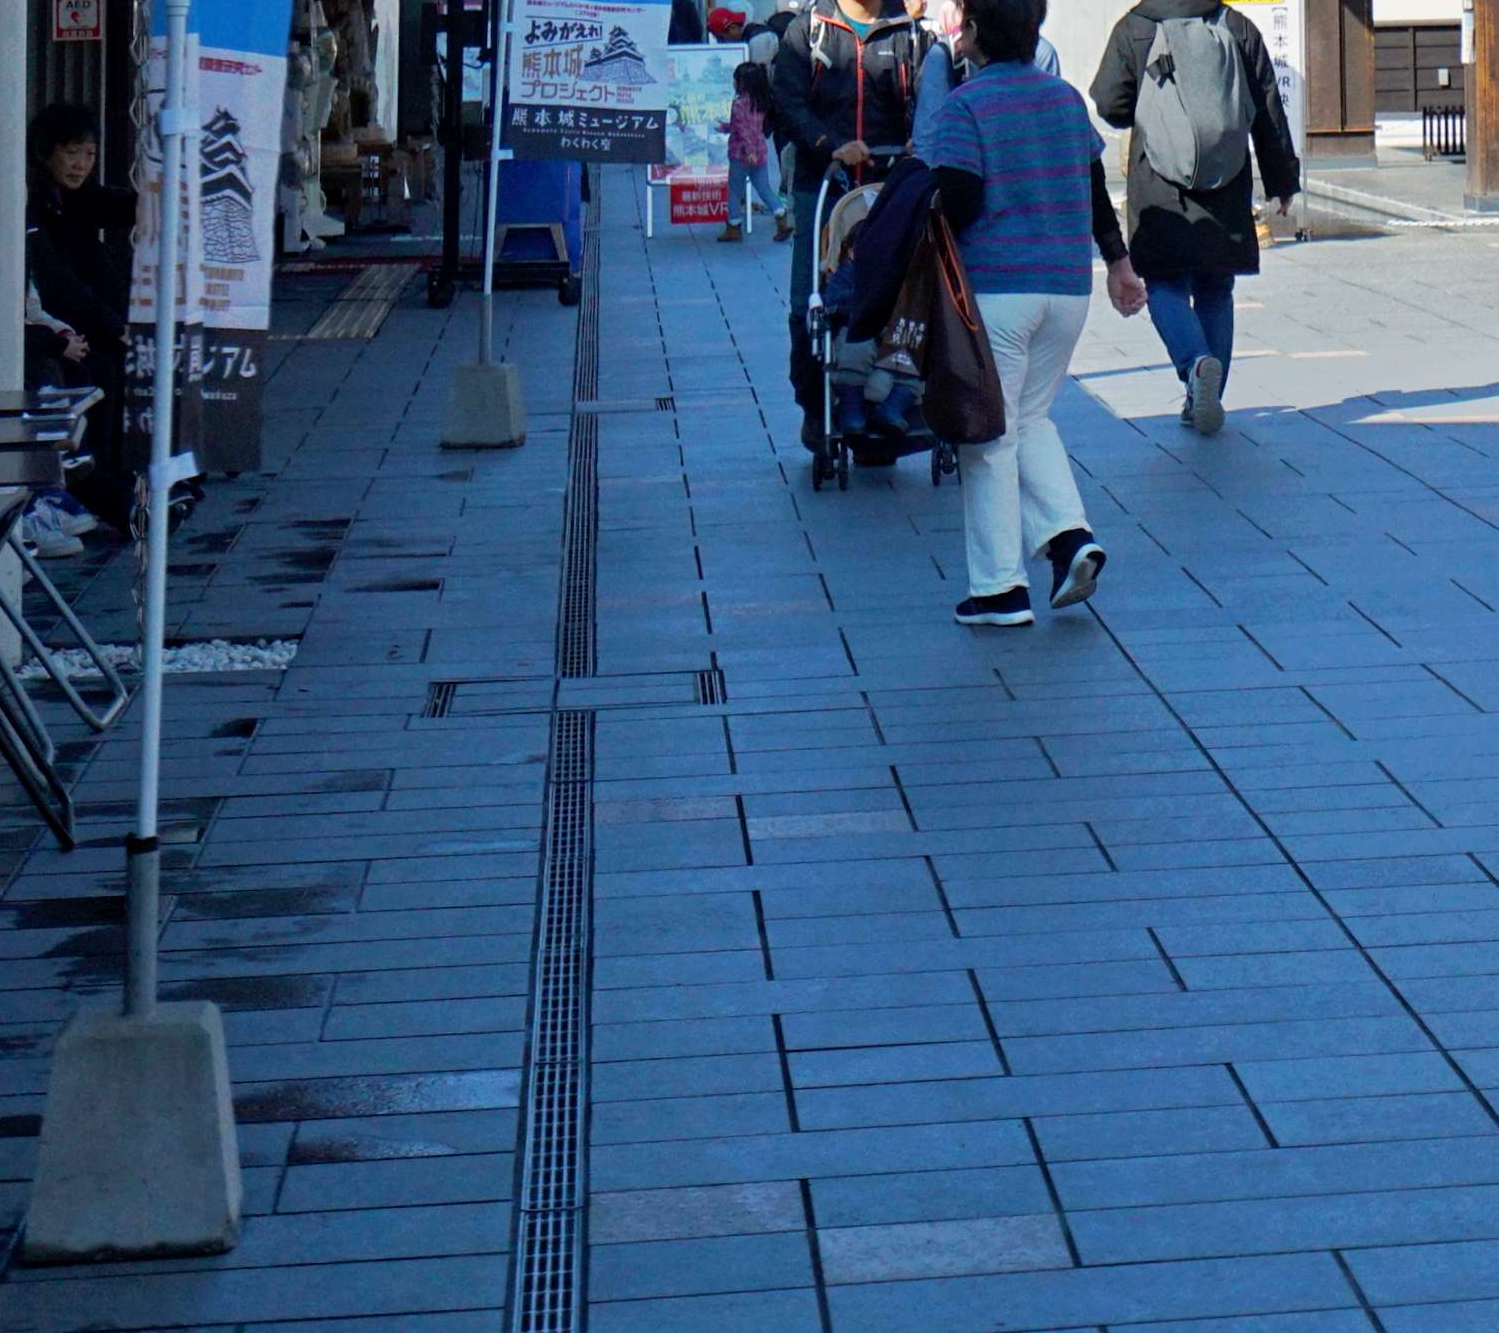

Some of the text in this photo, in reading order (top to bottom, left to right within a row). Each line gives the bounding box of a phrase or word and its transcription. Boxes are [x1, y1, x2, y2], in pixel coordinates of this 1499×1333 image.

[66, 0, 91, 9] AED
[521, 44, 584, 79] 熊本城
[521, 80, 616, 102] プロジェクト
